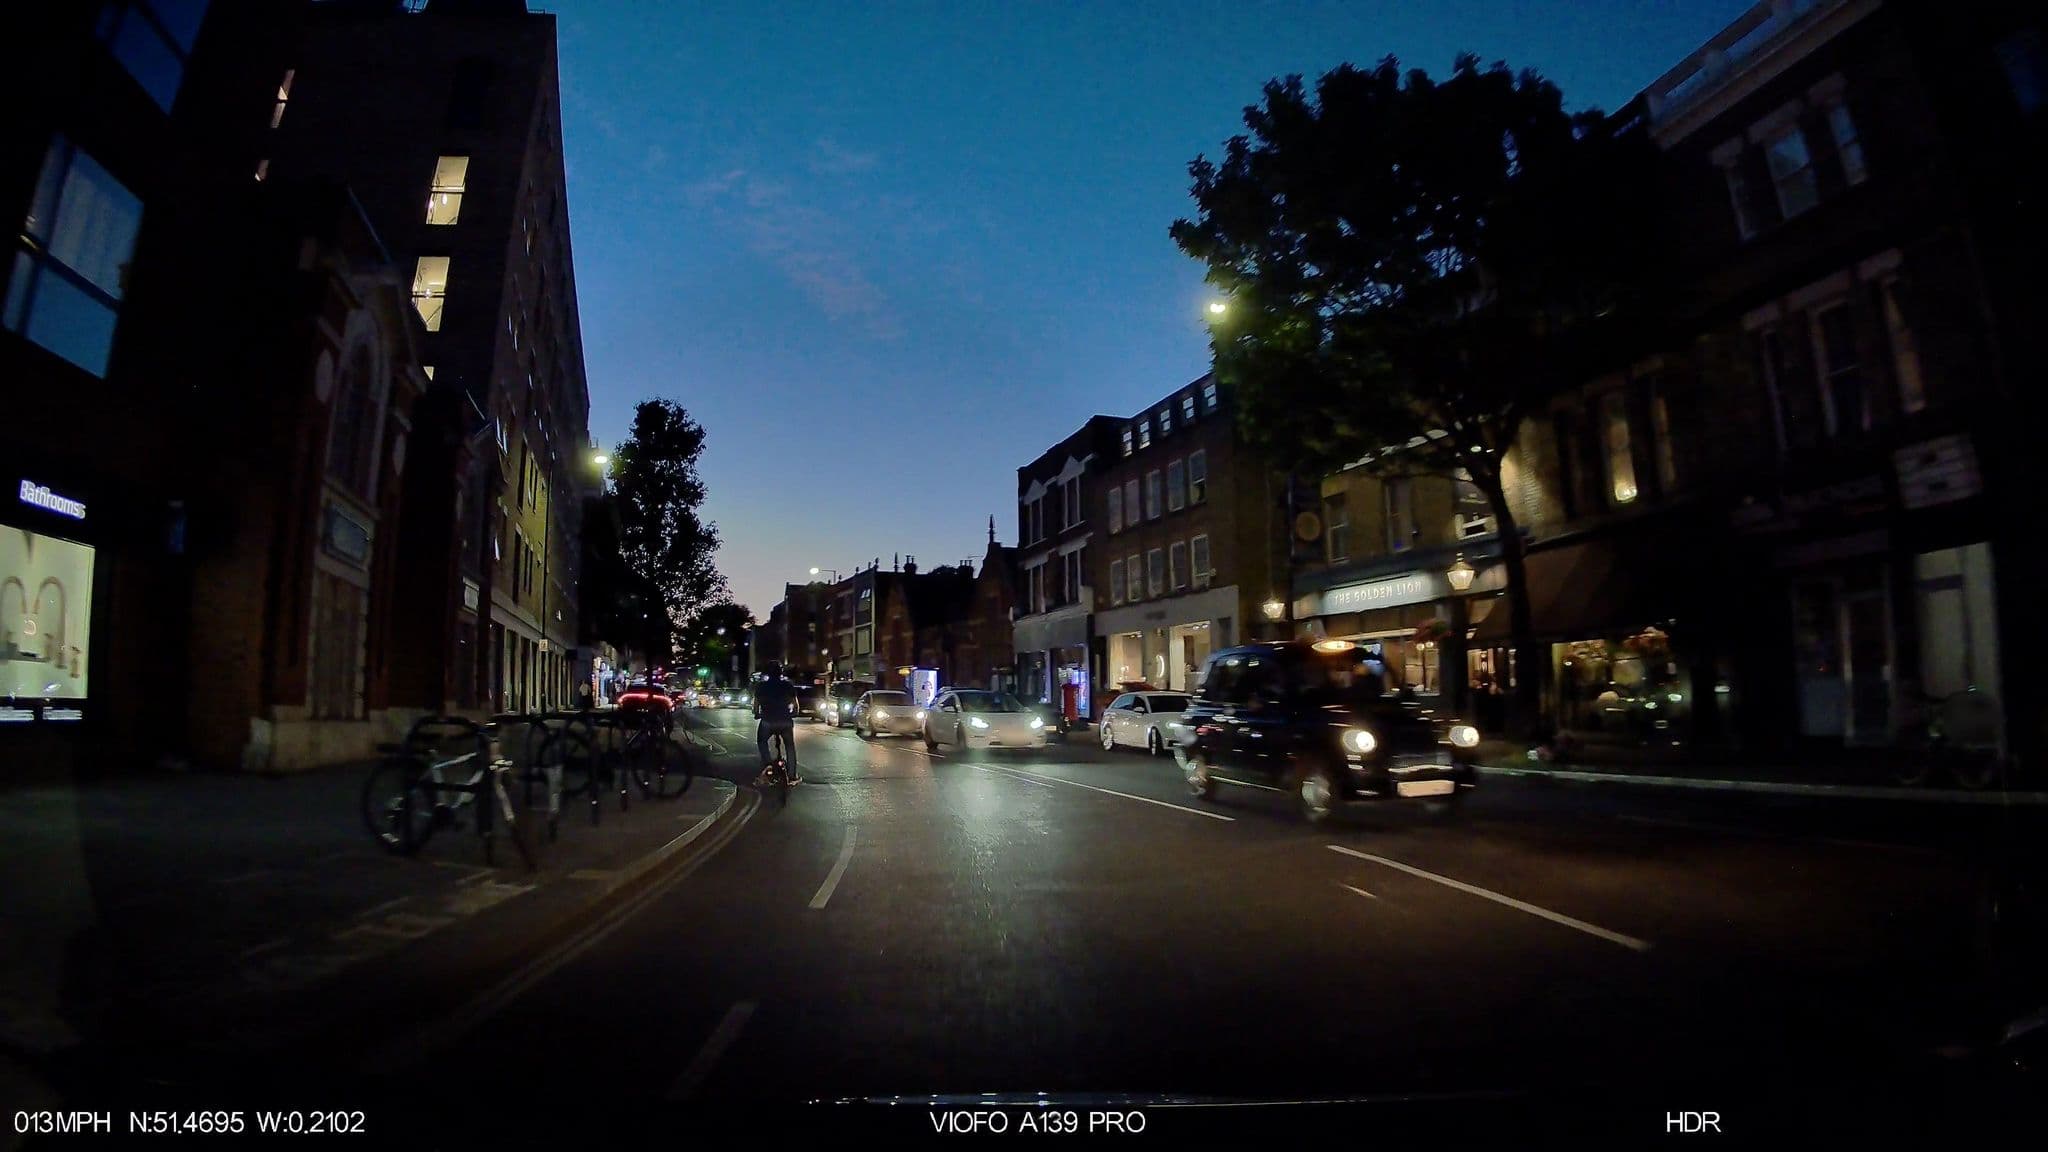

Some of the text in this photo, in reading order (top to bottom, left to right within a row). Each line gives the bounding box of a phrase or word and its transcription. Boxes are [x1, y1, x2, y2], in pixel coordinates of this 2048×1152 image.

[20, 479, 86, 519] Bathrooms
[1334, 580, 1422, 606] THE GOLDEN LION
